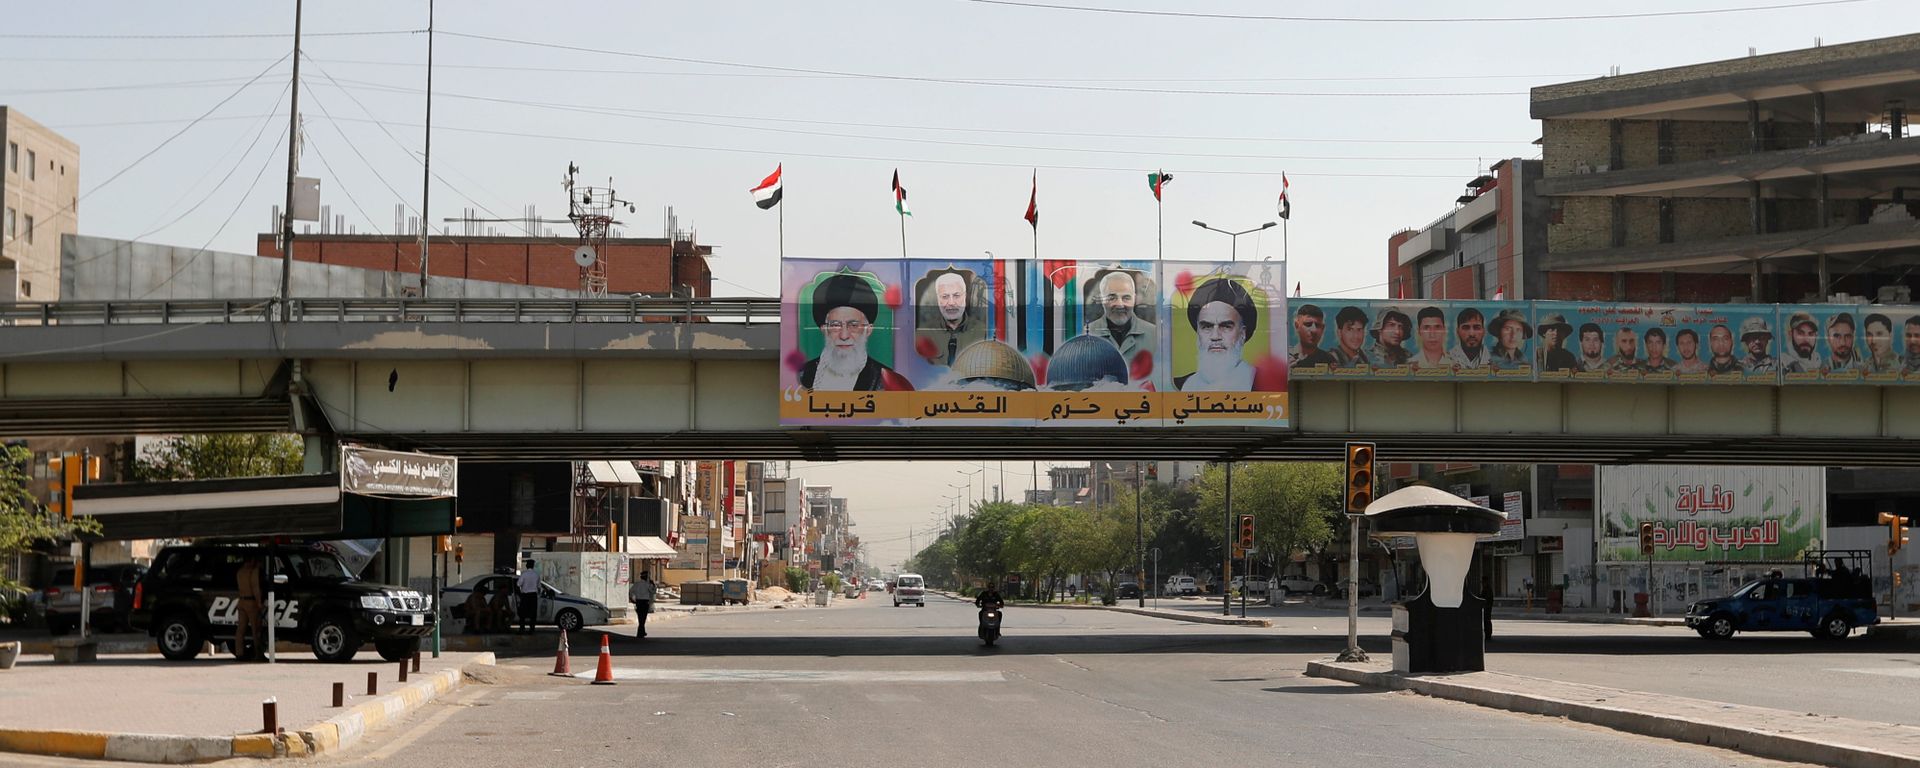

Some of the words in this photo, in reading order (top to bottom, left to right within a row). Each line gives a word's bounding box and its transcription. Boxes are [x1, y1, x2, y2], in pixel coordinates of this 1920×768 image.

[372, 459, 401, 479] الكندي
[421, 463, 440, 480] قاطع
[1676, 484, 1734, 516] منارة
[1712, 519, 1780, 550] للعرب
[208, 596, 299, 628] POCE
